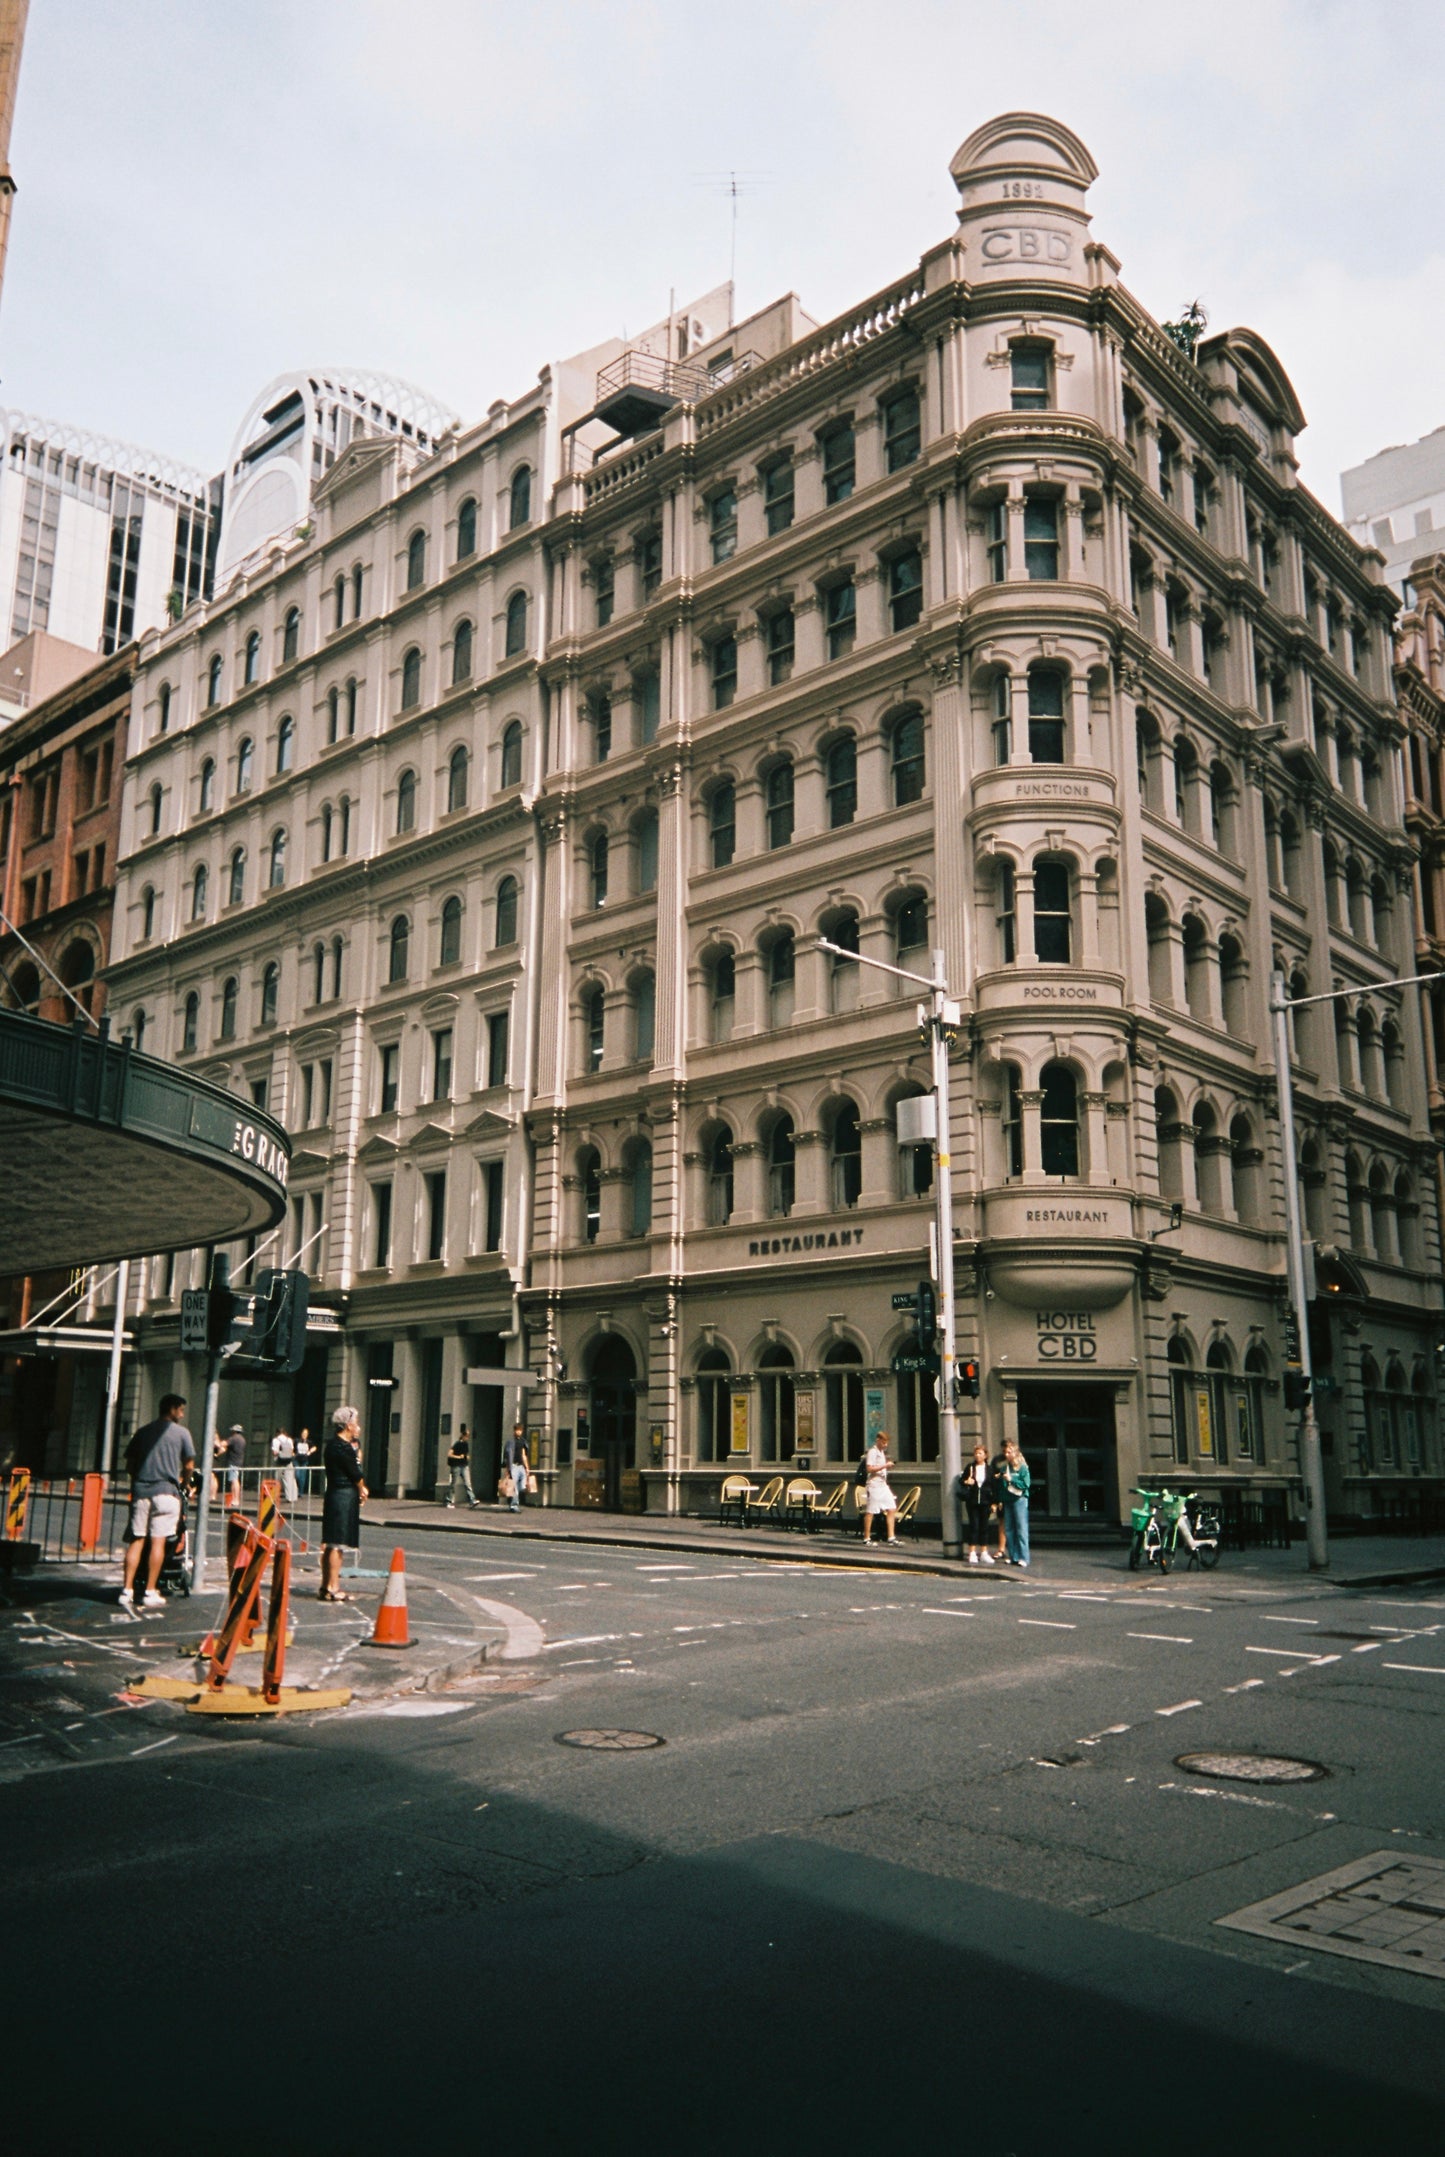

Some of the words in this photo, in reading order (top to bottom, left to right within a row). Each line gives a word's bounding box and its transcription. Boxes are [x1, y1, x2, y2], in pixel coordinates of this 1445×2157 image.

[981, 231, 1072, 261] CBD
[1016, 784, 1089, 796] FUNCTIONS
[1024, 987, 1057, 998] POOL
[1059, 987, 1097, 999] ROOM
[1026, 1210, 1109, 1223] RESTAURANT
[749, 1229, 864, 1256] RESTAURANT
[186, 1296, 205, 1310] ONE
[184, 1315, 205, 1329] WAY
[307, 1314, 335, 1324] MBERS
[1036, 1312, 1096, 1330] HOTEL
[1037, 1336, 1097, 1358] CBD
[903, 1358, 918, 1368] King
